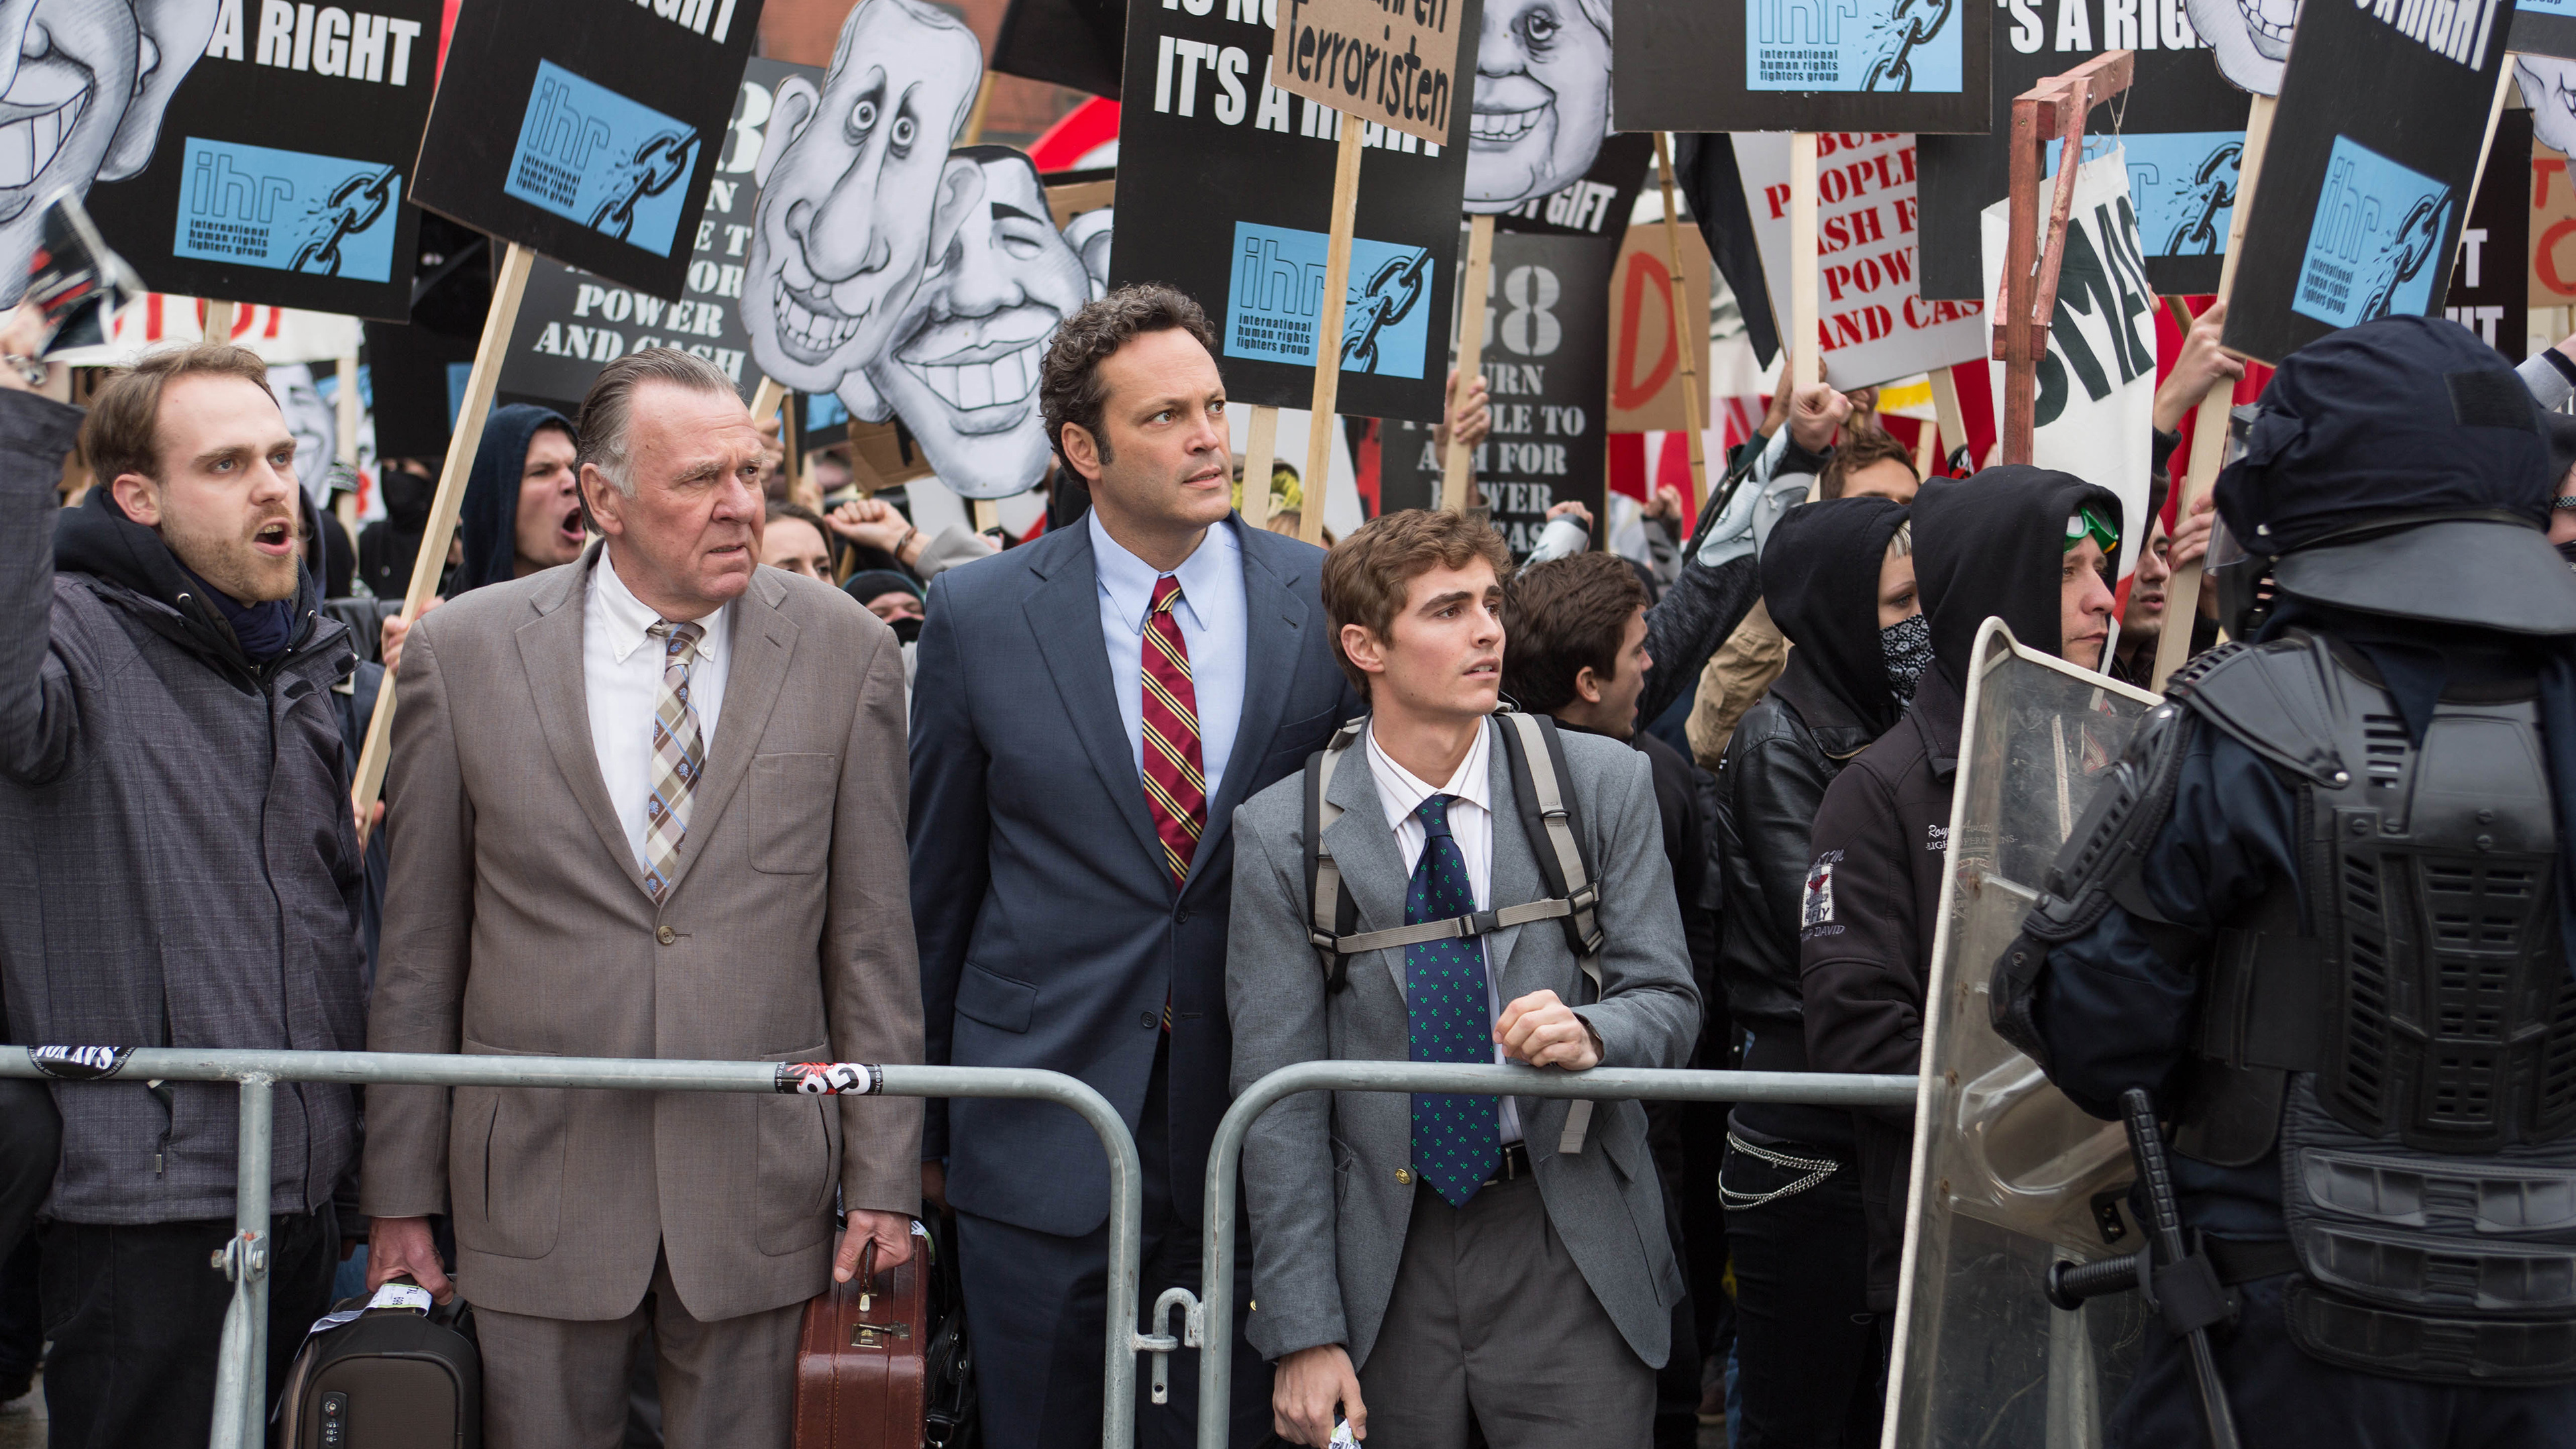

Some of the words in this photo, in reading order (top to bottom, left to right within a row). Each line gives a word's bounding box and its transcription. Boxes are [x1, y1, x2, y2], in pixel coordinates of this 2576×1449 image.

[2104, 0, 2212, 50] RIG
[256, 0, 421, 87] RIGHT
[1760, 48, 1838, 59] international
[1287, 0, 1448, 131] Terroristen
[1760, 60, 1799, 70] human
[1803, 60, 1838, 72] rights
[1760, 71, 1804, 82] fighters
[1807, 72, 1839, 83] group
[1155, 36, 1249, 126] IT'S
[1764, 147, 1917, 220] POPLE
[1545, 179, 1617, 233] GIFT
[189, 229, 229, 242] human
[233, 235, 268, 247] rights
[190, 219, 270, 237] international
[188, 239, 232, 253] fighters
[235, 246, 268, 258] group
[573, 283, 724, 338] POWER
[1239, 313, 1312, 333] international
[533, 321, 624, 363] AND
[1236, 336, 1277, 352] fighters
[1280, 343, 1310, 356] group
[1238, 325, 1274, 339] human
[1277, 331, 1310, 344] rights
[1540, 406, 1587, 436] TO
[1499, 443, 1567, 476] FOR
